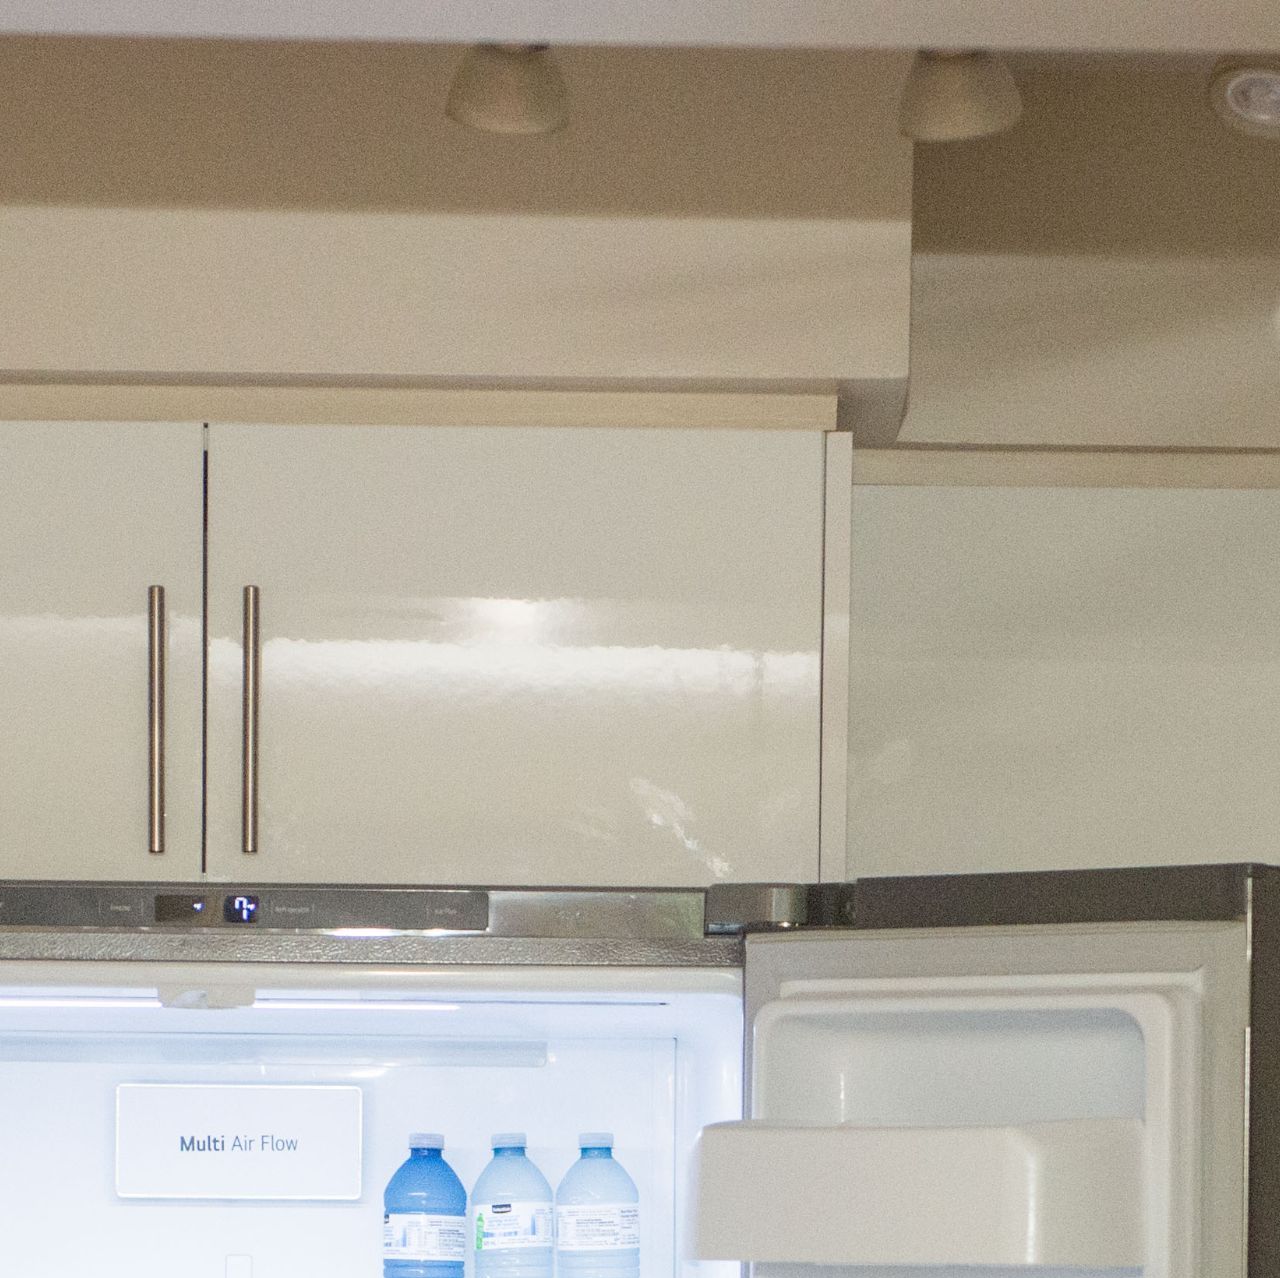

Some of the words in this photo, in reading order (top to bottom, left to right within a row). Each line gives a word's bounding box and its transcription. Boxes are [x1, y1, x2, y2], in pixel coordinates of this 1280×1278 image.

[179, 1135, 225, 1152] Multi
[231, 1135, 255, 1152] Air
[261, 1135, 299, 1152] Flow
